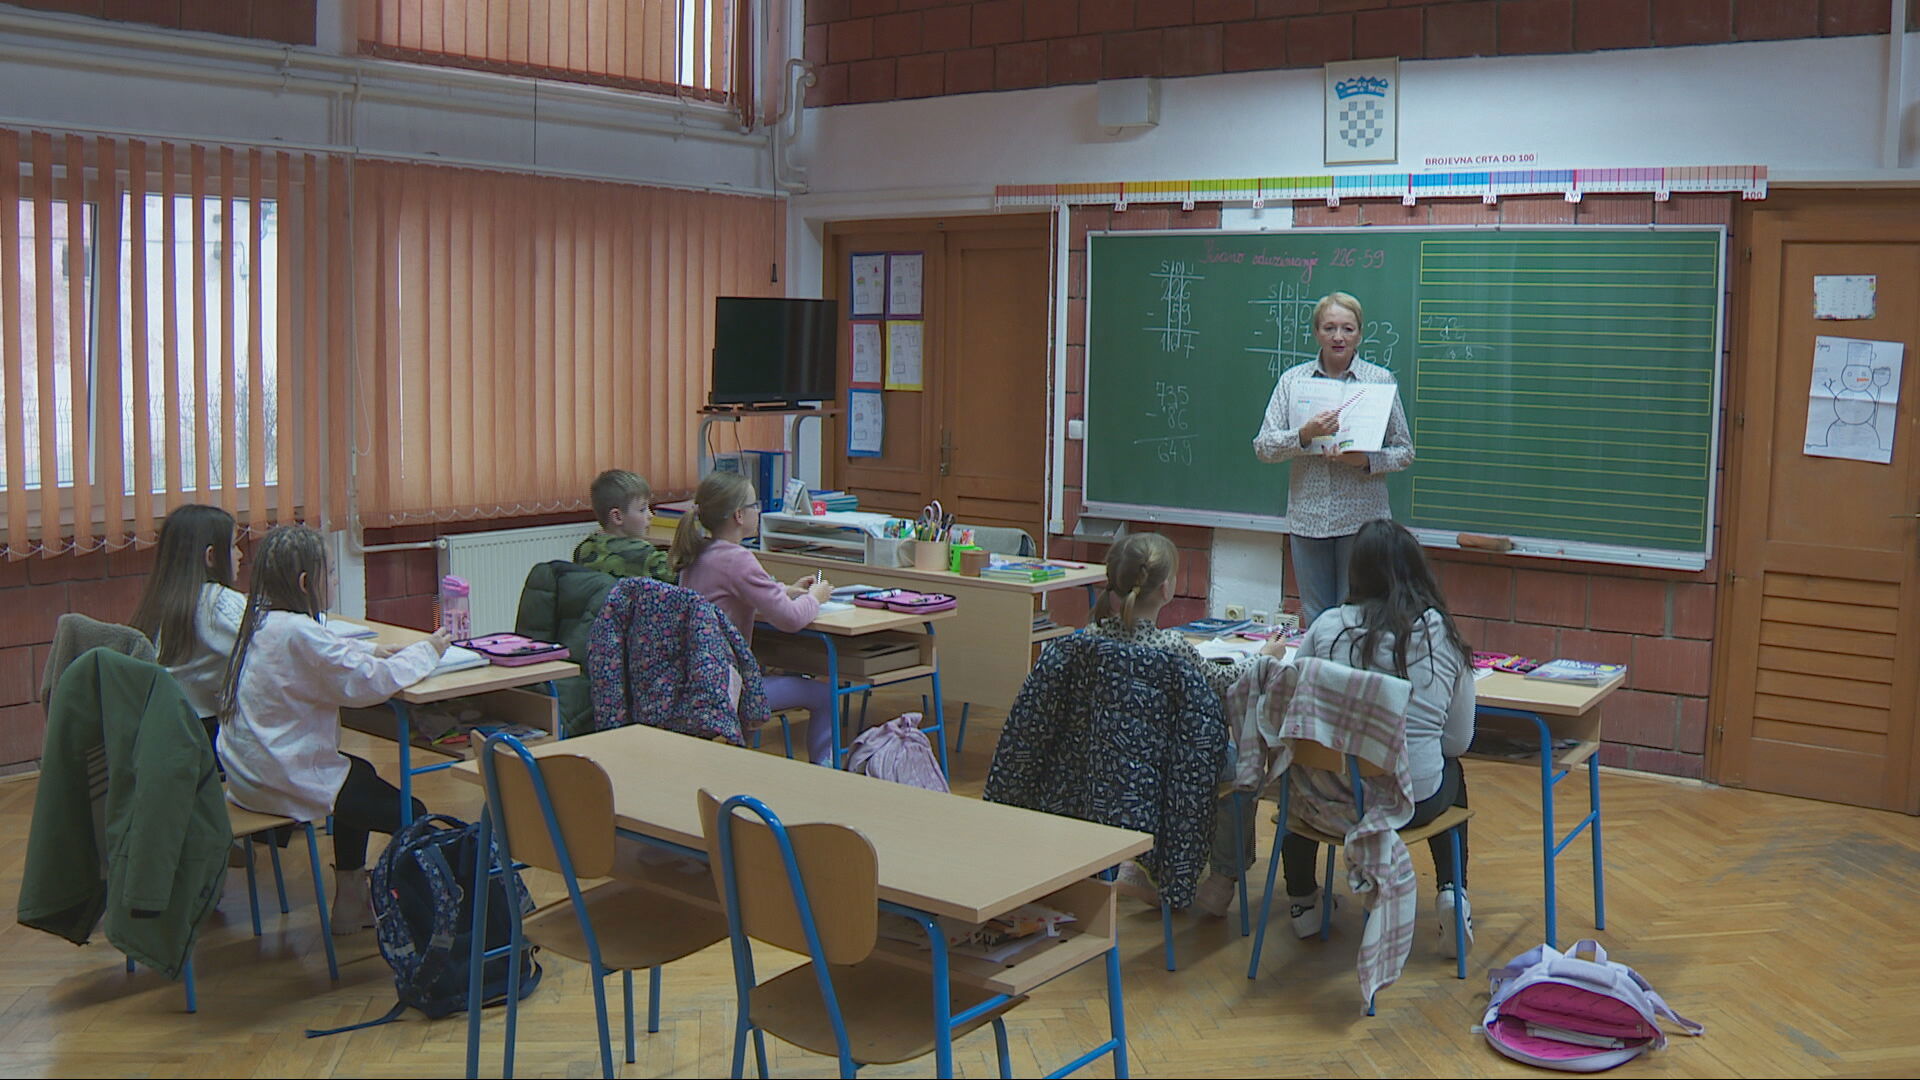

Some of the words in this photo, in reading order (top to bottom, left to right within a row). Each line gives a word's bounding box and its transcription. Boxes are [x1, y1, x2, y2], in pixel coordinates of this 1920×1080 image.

[1425, 156, 1473, 166] BROJEVNA
[1475, 155, 1500, 164] CRTA
[1502, 154, 1516, 163] DO
[1519, 153, 1535, 162] 100
[1115, 203, 1127, 211] 20
[1328, 199, 1339, 207] 50
[1484, 195, 1495, 203] 70
[1745, 191, 1763, 199] 100
